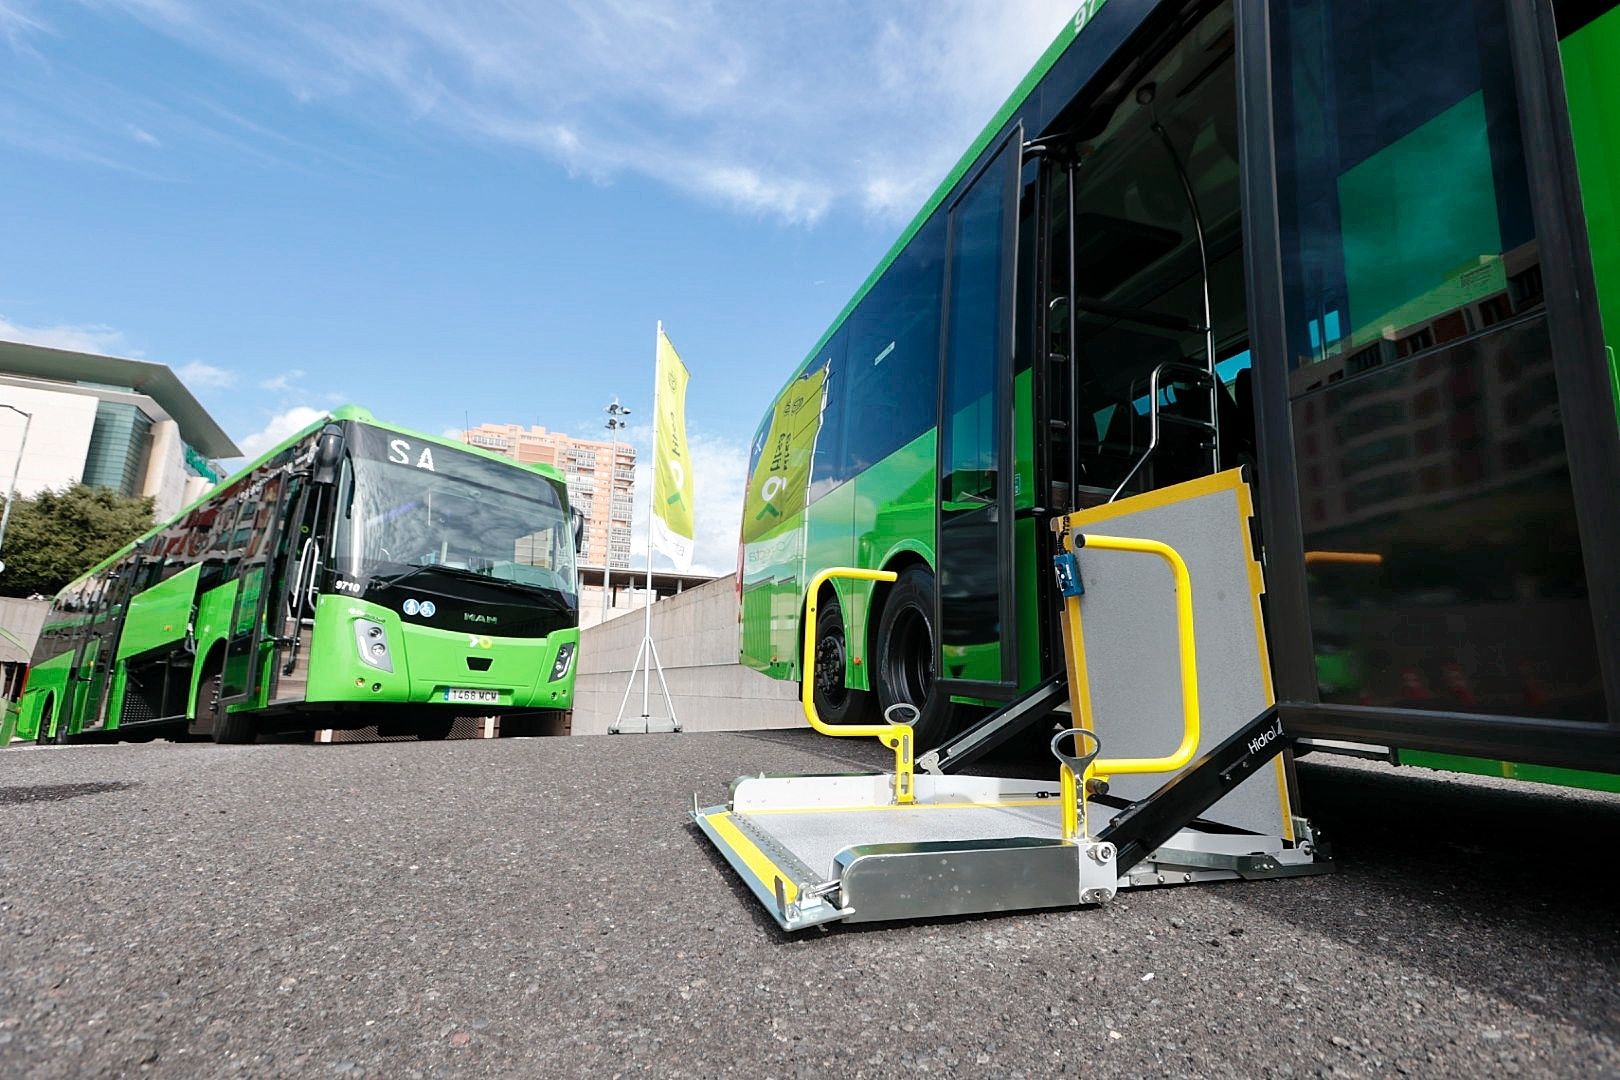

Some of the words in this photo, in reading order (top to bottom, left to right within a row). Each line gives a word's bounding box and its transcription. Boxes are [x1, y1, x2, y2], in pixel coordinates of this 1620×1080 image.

[335, 579, 361, 592] 9710
[453, 689, 476, 700] 1468
[1247, 725, 1278, 755] Hidral
